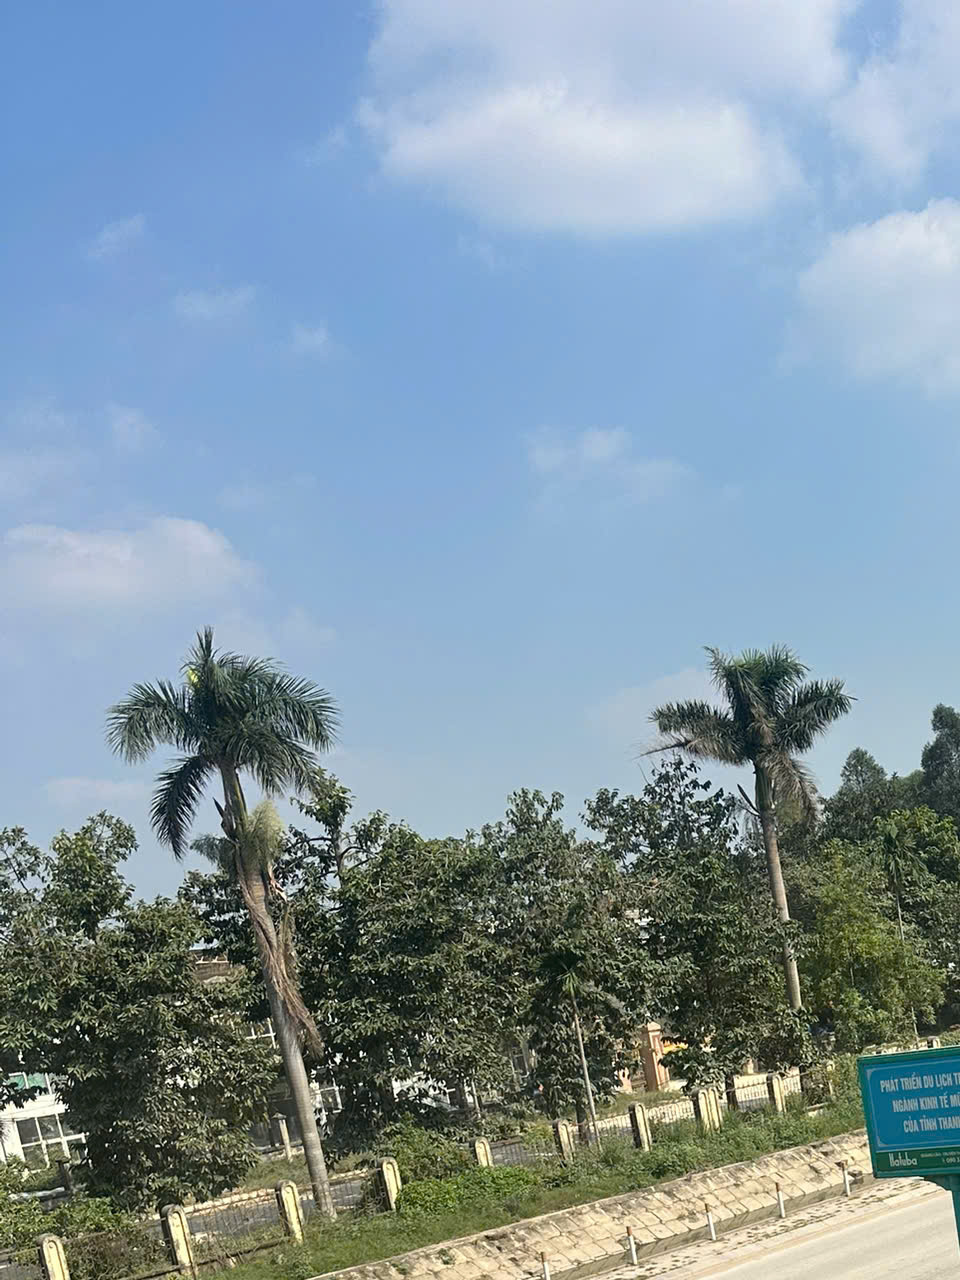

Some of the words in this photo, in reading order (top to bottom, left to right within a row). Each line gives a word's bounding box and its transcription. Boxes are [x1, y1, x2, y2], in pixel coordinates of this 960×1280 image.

[880, 1076, 899, 1093] PHÁT
[900, 1072, 922, 1091] TRIỂN
[923, 1075, 934, 1089] DU
[935, 1072, 953, 1090] LỊCH
[892, 1096, 919, 1113] NGÀNH
[920, 1096, 938, 1111] KINH
[939, 1091, 949, 1109] TẾ
[903, 1115, 919, 1133] CỦA
[920, 1115, 937, 1132] TỈNH
